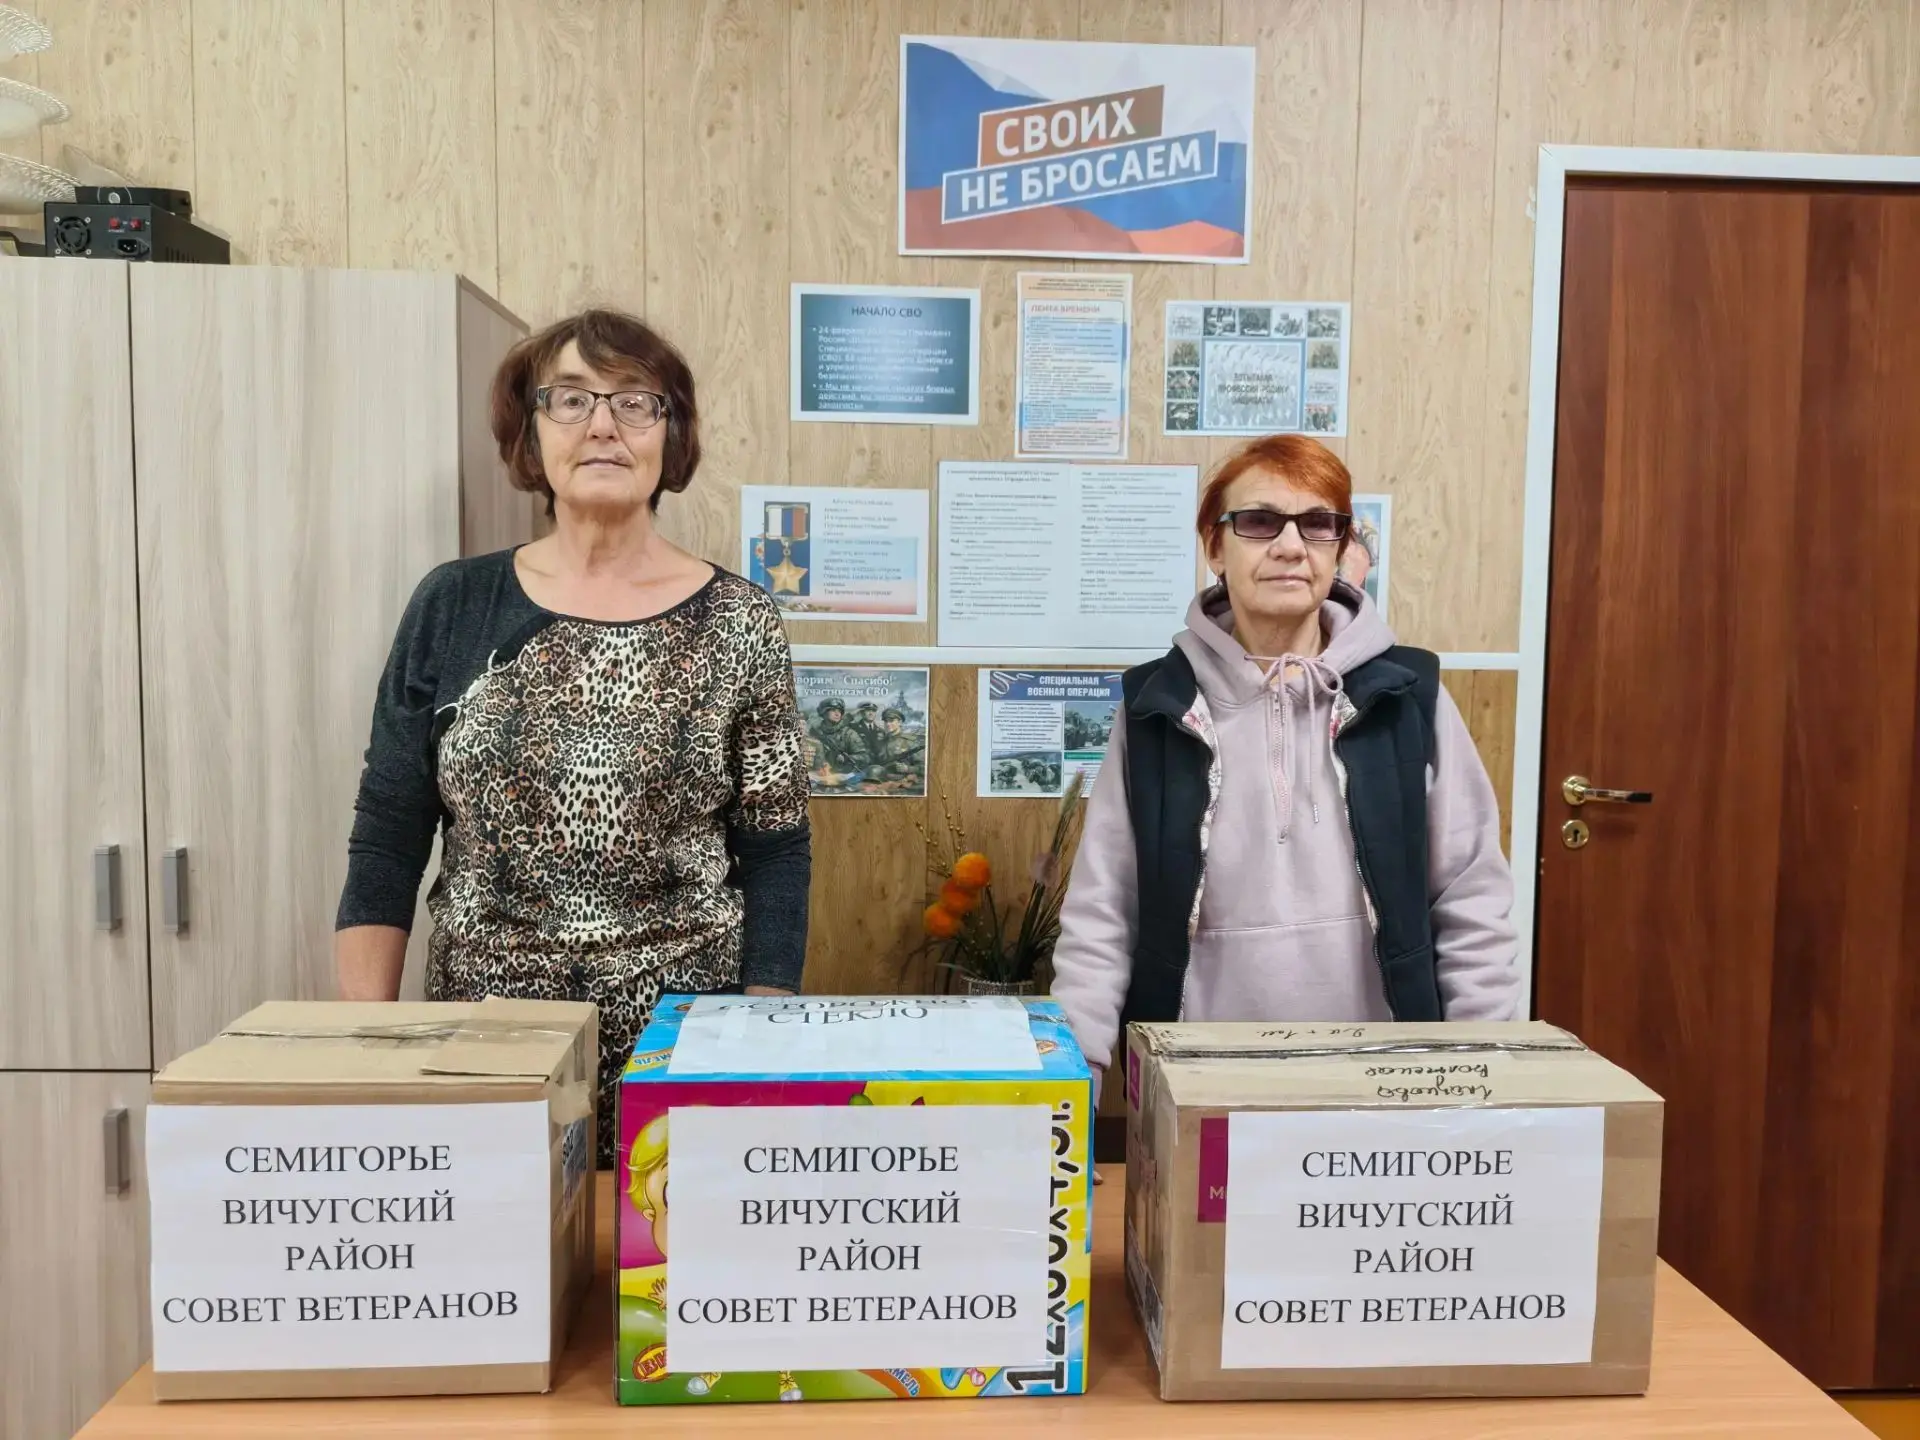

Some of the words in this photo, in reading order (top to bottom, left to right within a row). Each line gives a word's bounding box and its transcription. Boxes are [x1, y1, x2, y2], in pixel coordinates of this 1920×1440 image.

[996, 98, 1136, 157] СВОИХ
[961, 172, 1009, 212] НЕ
[1021, 138, 1202, 202] БРОСАЕМ
[851, 306, 896, 318] НАЧАЛО
[899, 307, 922, 318] СВО
[796, 675, 833, 687] ворим
[866, 686, 889, 697] СВО
[1027, 687, 1065, 697] ВОЕННАЯ
[1067, 687, 1111, 698] ОПЕРАЦИЯ
[1039, 675, 1099, 685] СПЕЦИАЛЬНАЯ
[768, 1006, 928, 1024] СТЕКЛО
[225, 1145, 452, 1174] СЕМИГОРЬЕ
[743, 1146, 960, 1174] СЕМИГОРЬЕ
[1301, 1150, 1514, 1178] СЕМИГОРЬЕ
[223, 1189, 455, 1225] ВИЧУГСКИЙ
[740, 1190, 961, 1225] ВИЧУГСКИЙ
[1298, 1193, 1514, 1228] ВИЧУГСКИЙ
[285, 1237, 414, 1271] РАЙОН
[798, 1238, 921, 1272] РАЙОН
[1353, 1241, 1474, 1274] РАЙОН
[163, 1297, 286, 1323] СОВЕТ
[298, 1291, 519, 1322] ВЕТЕРАНОВ
[677, 1297, 797, 1324] СОВЕТ
[807, 1295, 1018, 1322] ВЕТЕРАНОВ
[1235, 1299, 1352, 1324] СОВЕТ
[1361, 1294, 1567, 1323] ВЕТЕРАНОВ
